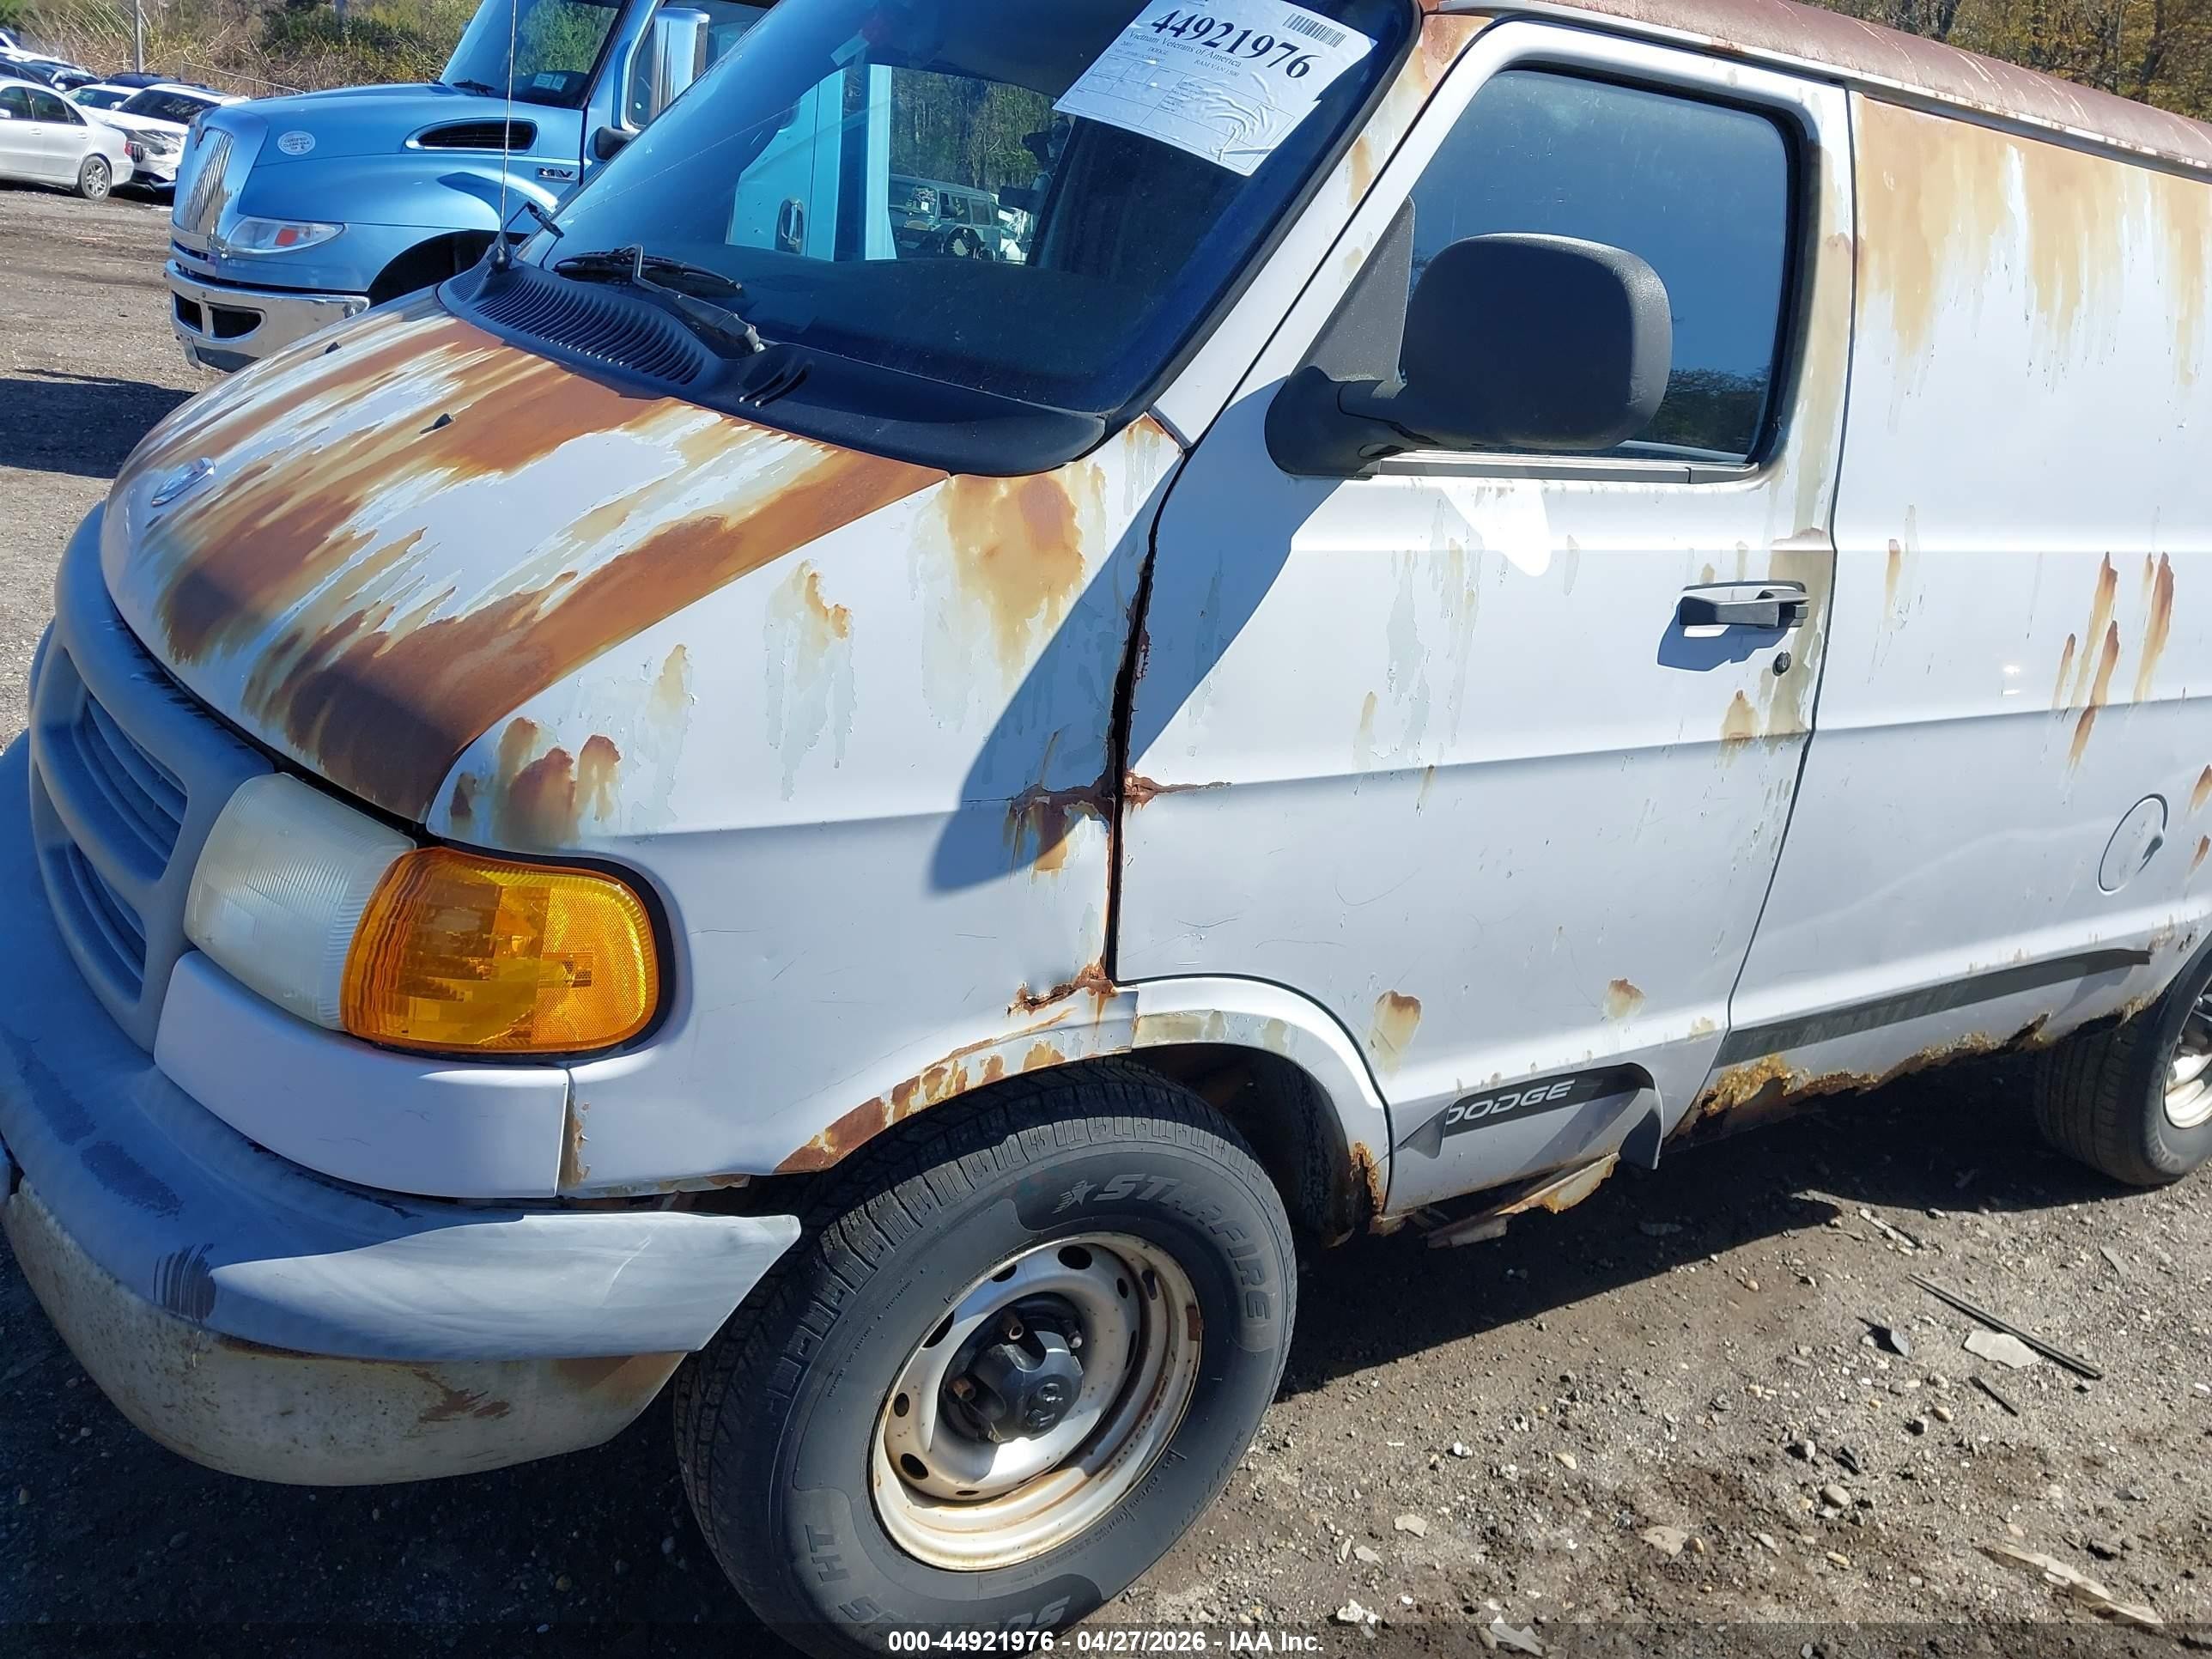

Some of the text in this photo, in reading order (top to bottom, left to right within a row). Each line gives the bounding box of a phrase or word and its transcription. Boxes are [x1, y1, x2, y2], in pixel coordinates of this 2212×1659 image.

[1129, 31, 1242, 68] Vietnam Veterans of America
[1151, 9, 1322, 78] 44921976
[1445, 1079, 1576, 1125] DODGE
[1093, 1173, 1271, 1320] STARFIRE
